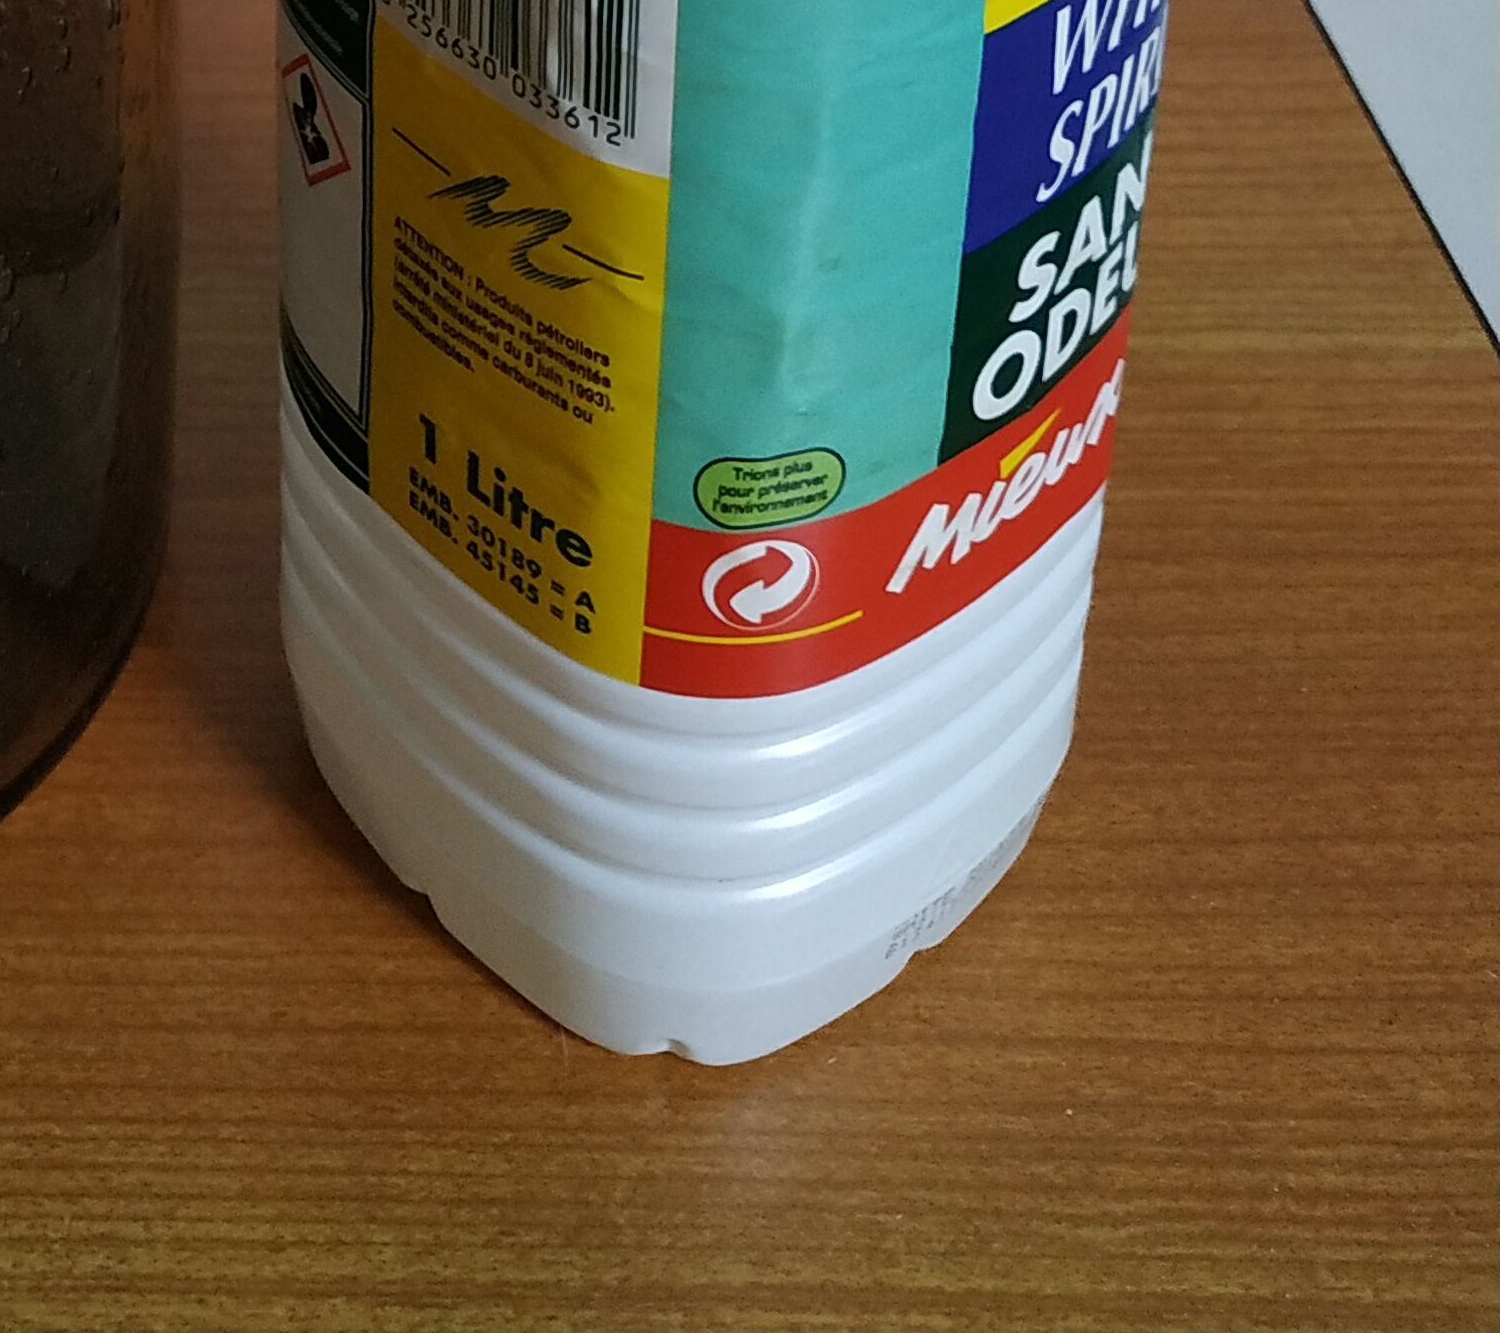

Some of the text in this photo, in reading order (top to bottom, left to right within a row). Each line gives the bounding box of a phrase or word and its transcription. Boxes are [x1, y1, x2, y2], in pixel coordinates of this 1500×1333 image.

[406, 4, 498, 82] 256630
[512, 65, 622, 148] 033612
[1008, 129, 1154, 323] SAN
[394, 215, 464, 281] ATTENTION
[474, 279, 533, 326] Produits
[537, 319, 610, 367] pétroliers
[433, 292, 500, 347] ministériel
[503, 340, 522, 361] du
[524, 351, 534, 369] 8
[536, 357, 565, 387] juin
[441, 275, 463, 303] aux
[466, 296, 515, 336] usages
[441, 320, 489, 362] comme
[492, 355, 569, 413] carburants
[572, 404, 594, 425] ou
[418, 414, 594, 569] 1 Litre
[712, 489, 828, 515] l'environnement
[717, 473, 829, 500] pour préserver
[733, 460, 814, 482] Trions plus
[409, 467, 461, 526] EMB.
[466, 504, 543, 582] 30189
[574, 590, 597, 615] A
[409, 490, 460, 547] EMB.
[466, 539, 541, 607] 45145
[574, 613, 593, 636] B
